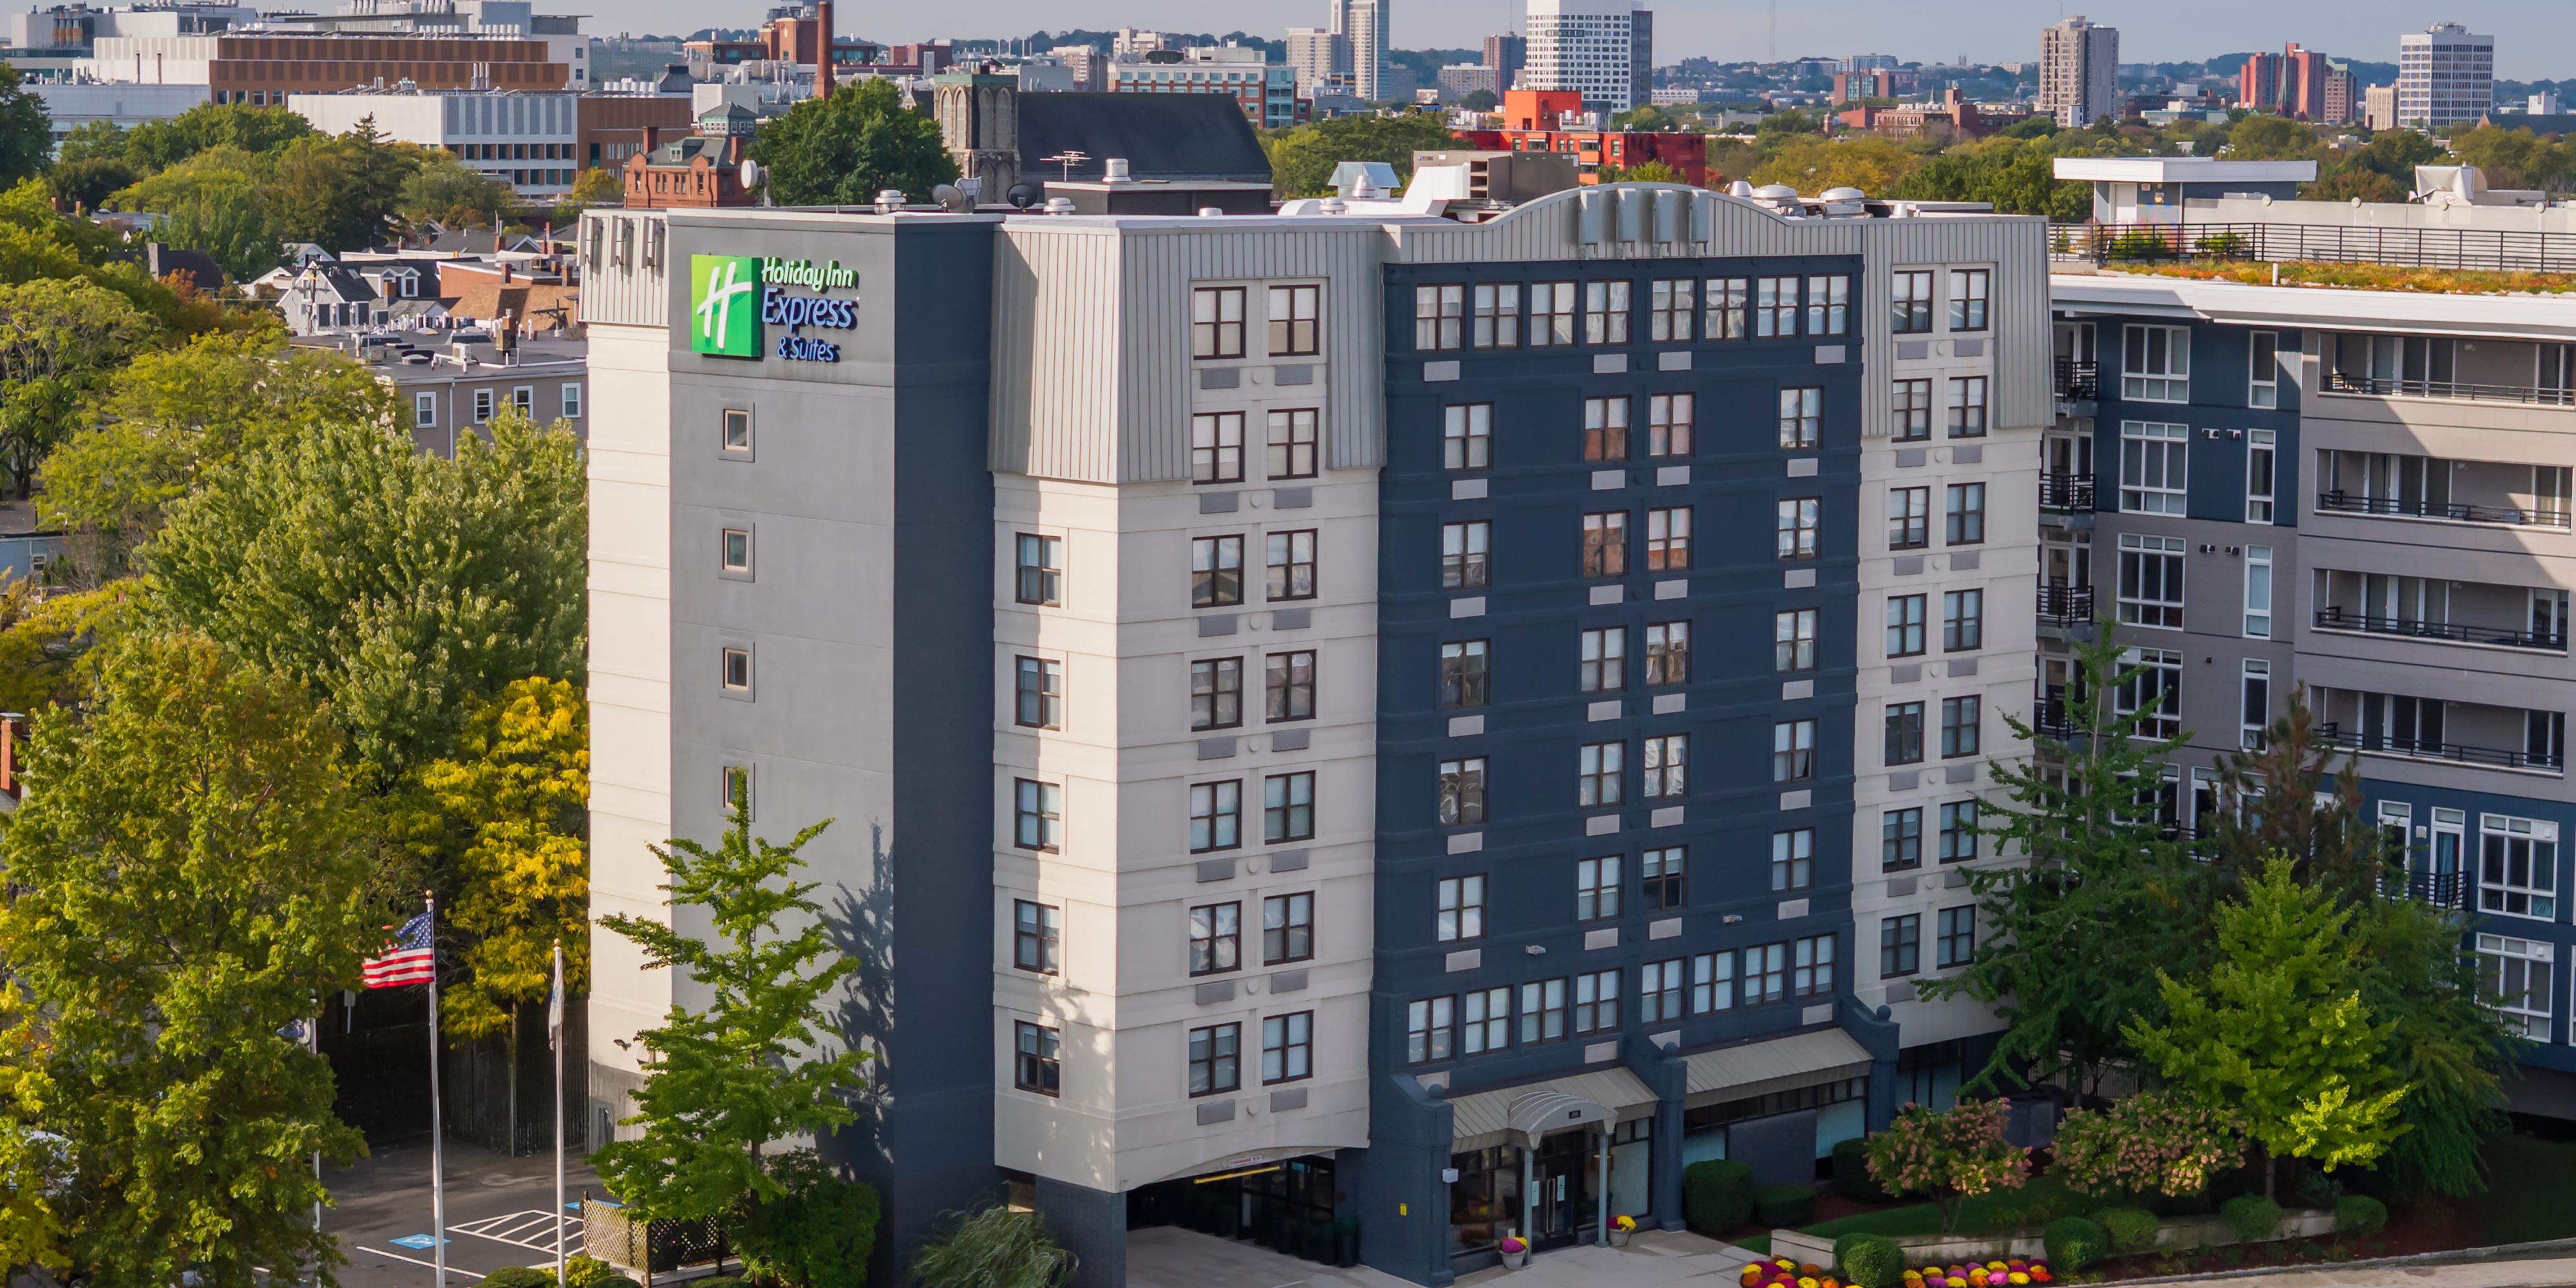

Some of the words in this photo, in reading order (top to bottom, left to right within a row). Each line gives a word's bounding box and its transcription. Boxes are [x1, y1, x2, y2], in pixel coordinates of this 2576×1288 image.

[761, 256, 824, 292] Holiday
[825, 259, 854, 288] Inn
[761, 287, 853, 334] Express
[777, 336, 788, 359] &
[790, 336, 835, 362] Suites
